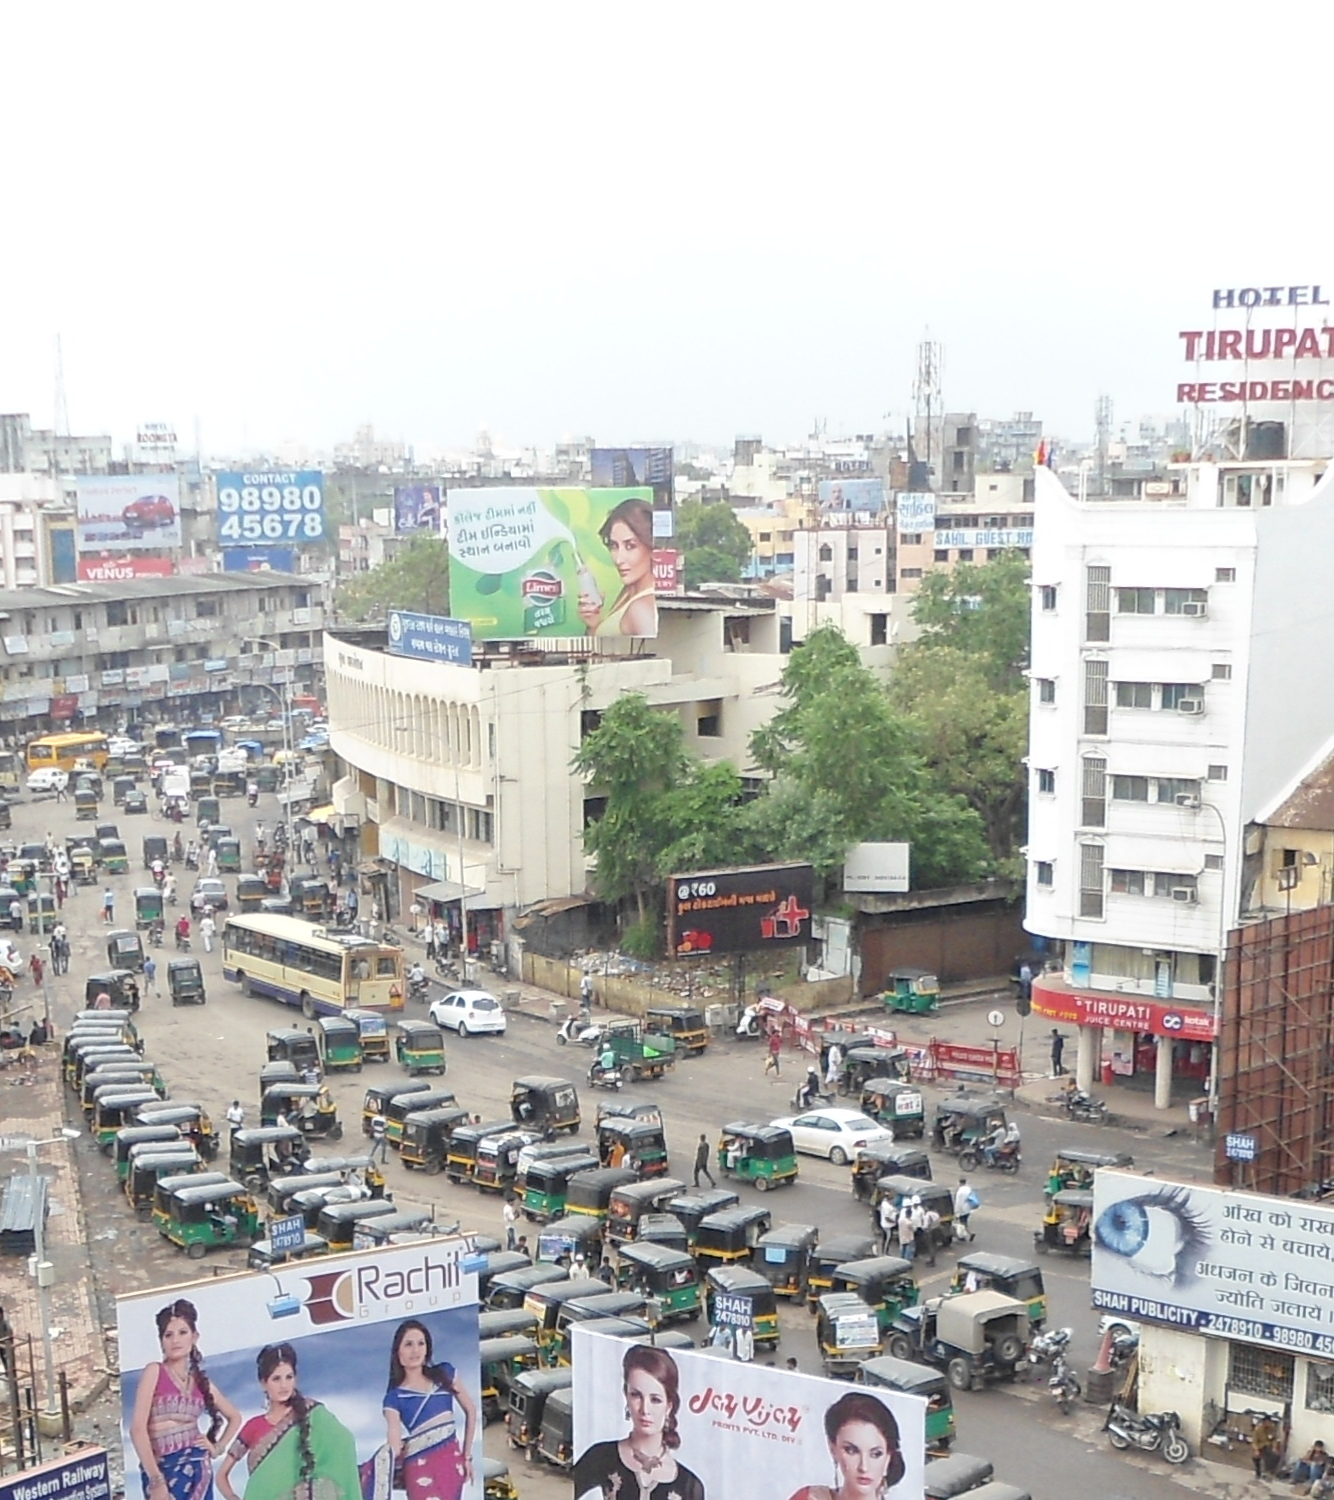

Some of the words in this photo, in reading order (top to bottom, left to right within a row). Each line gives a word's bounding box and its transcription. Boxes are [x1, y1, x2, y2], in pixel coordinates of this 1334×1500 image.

[1212, 285, 1330, 309] HOTEL
[243, 473, 297, 485] CONTACT
[219, 485, 322, 512] 98980
[221, 513, 323, 539] 45678
[936, 531, 968, 545] SAHIL
[975, 530, 1011, 545] GUEST
[87, 567, 134, 580] VENUS
[652, 564, 674, 579] NUS
[1084, 1000, 1151, 1020] TIRUPATI
[1084, 1015, 1110, 1026] JUICE
[1113, 1018, 1150, 1031] CENTRE
[1225, 1135, 1255, 1150] SHAH
[271, 1218, 301, 1236] SHAH
[1259, 1233, 1275, 1251] से
[357, 1250, 460, 1304] Rachit
[1259, 1270, 1278, 1288] के
[715, 1296, 752, 1315] SHAH
[715, 1310, 750, 1327] 2478910
[1093, 1291, 1129, 1312] SHAH
[1131, 1296, 1198, 1326] PUBLICITY
[1207, 1315, 1262, 1339] 2478910
[1273, 1329, 1312, 1349] 98980
[688, 1387, 738, 1419] Jay
[742, 1395, 802, 1433] Vijay
[712, 1419, 741, 1432] PRINTS
[62, 1462, 105, 1490] Railway
